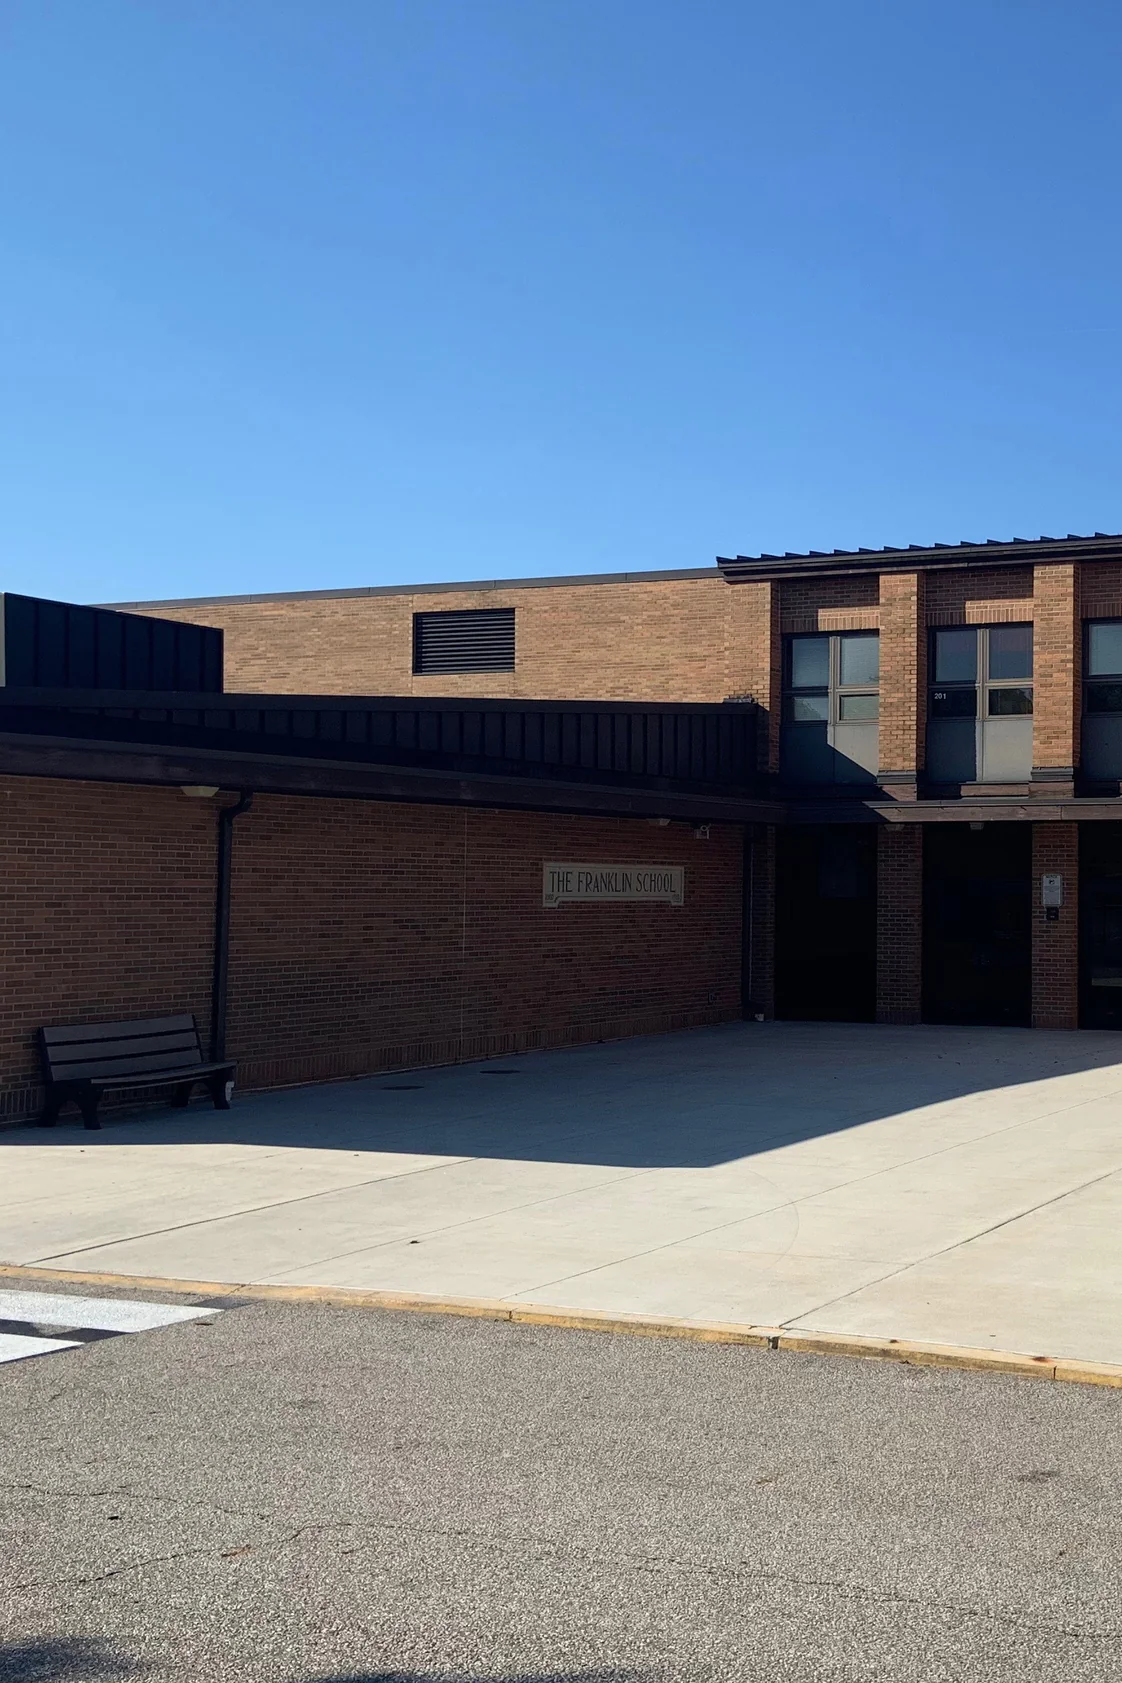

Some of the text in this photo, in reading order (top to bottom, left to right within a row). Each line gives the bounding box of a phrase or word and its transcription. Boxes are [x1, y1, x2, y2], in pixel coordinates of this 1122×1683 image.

[549, 871, 675, 892] THE FRANKLIN SCHOOL
